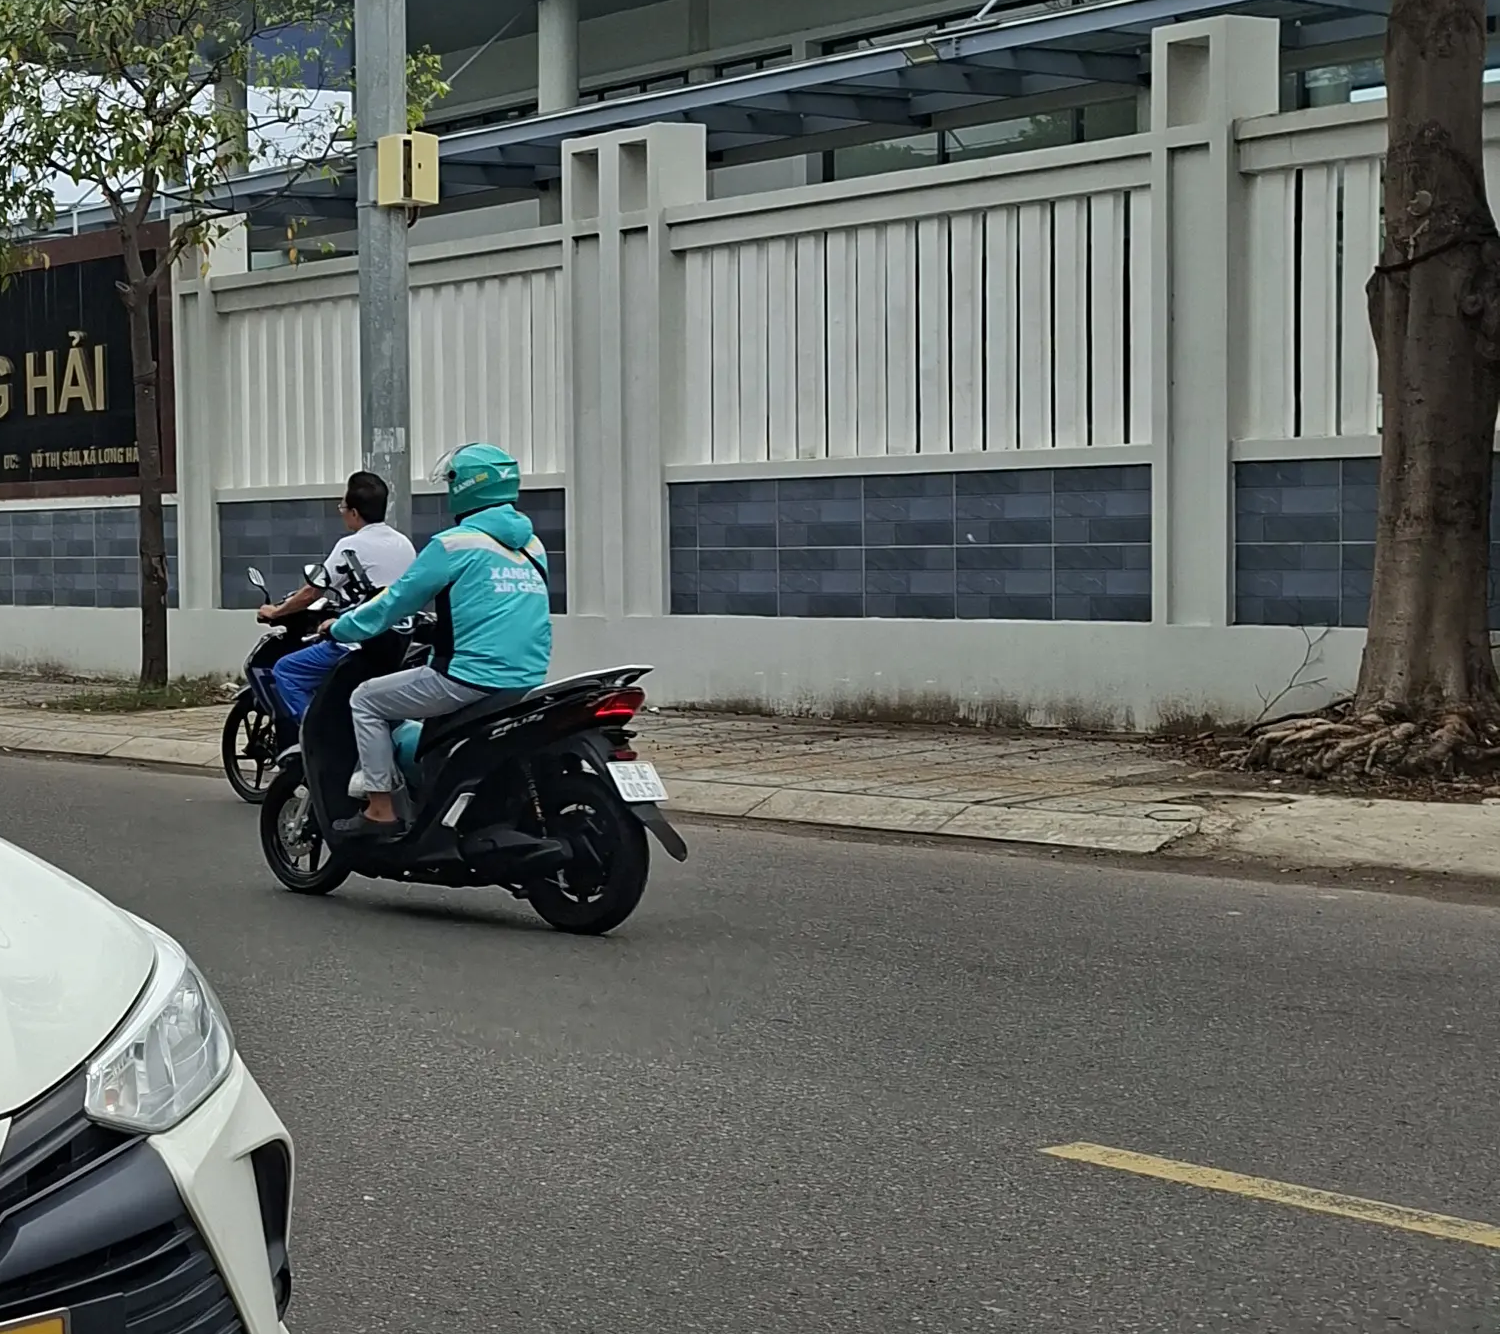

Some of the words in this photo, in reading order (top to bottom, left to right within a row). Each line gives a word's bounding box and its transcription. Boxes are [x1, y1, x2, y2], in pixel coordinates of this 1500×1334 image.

[25, 330, 108, 416] HẢI
[98, 445, 124, 465] LONG
[489, 566, 530, 581] XANH
